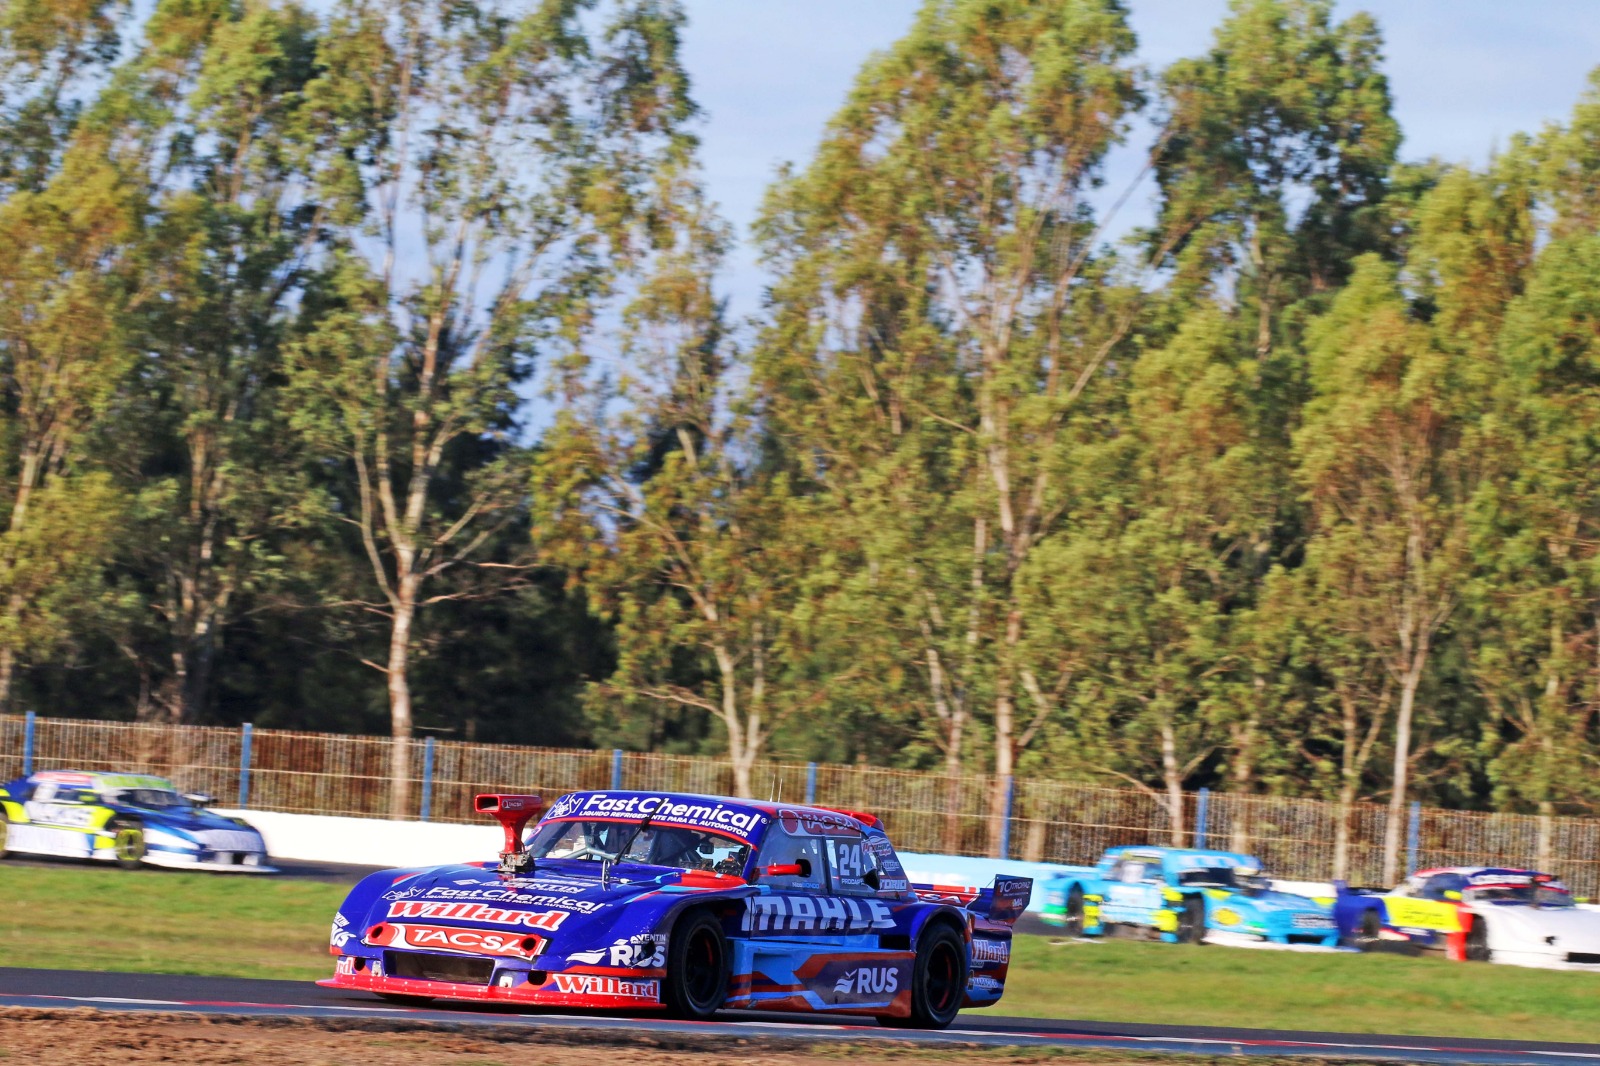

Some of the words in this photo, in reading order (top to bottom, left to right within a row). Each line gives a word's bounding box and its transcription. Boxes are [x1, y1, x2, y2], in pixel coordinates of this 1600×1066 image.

[667, 815, 688, 824] PARA
[688, 818, 698, 826] EL
[698, 820, 749, 838] AUTOMOTOR
[802, 813, 854, 831] TACSA
[839, 843, 861, 877] 24
[387, 901, 570, 931] Willard
[543, 902, 593, 915] AUTOMOTOR
[741, 896, 897, 931] MAHLE
[553, 974, 660, 998] Willard
[857, 967, 899, 994] RUS
